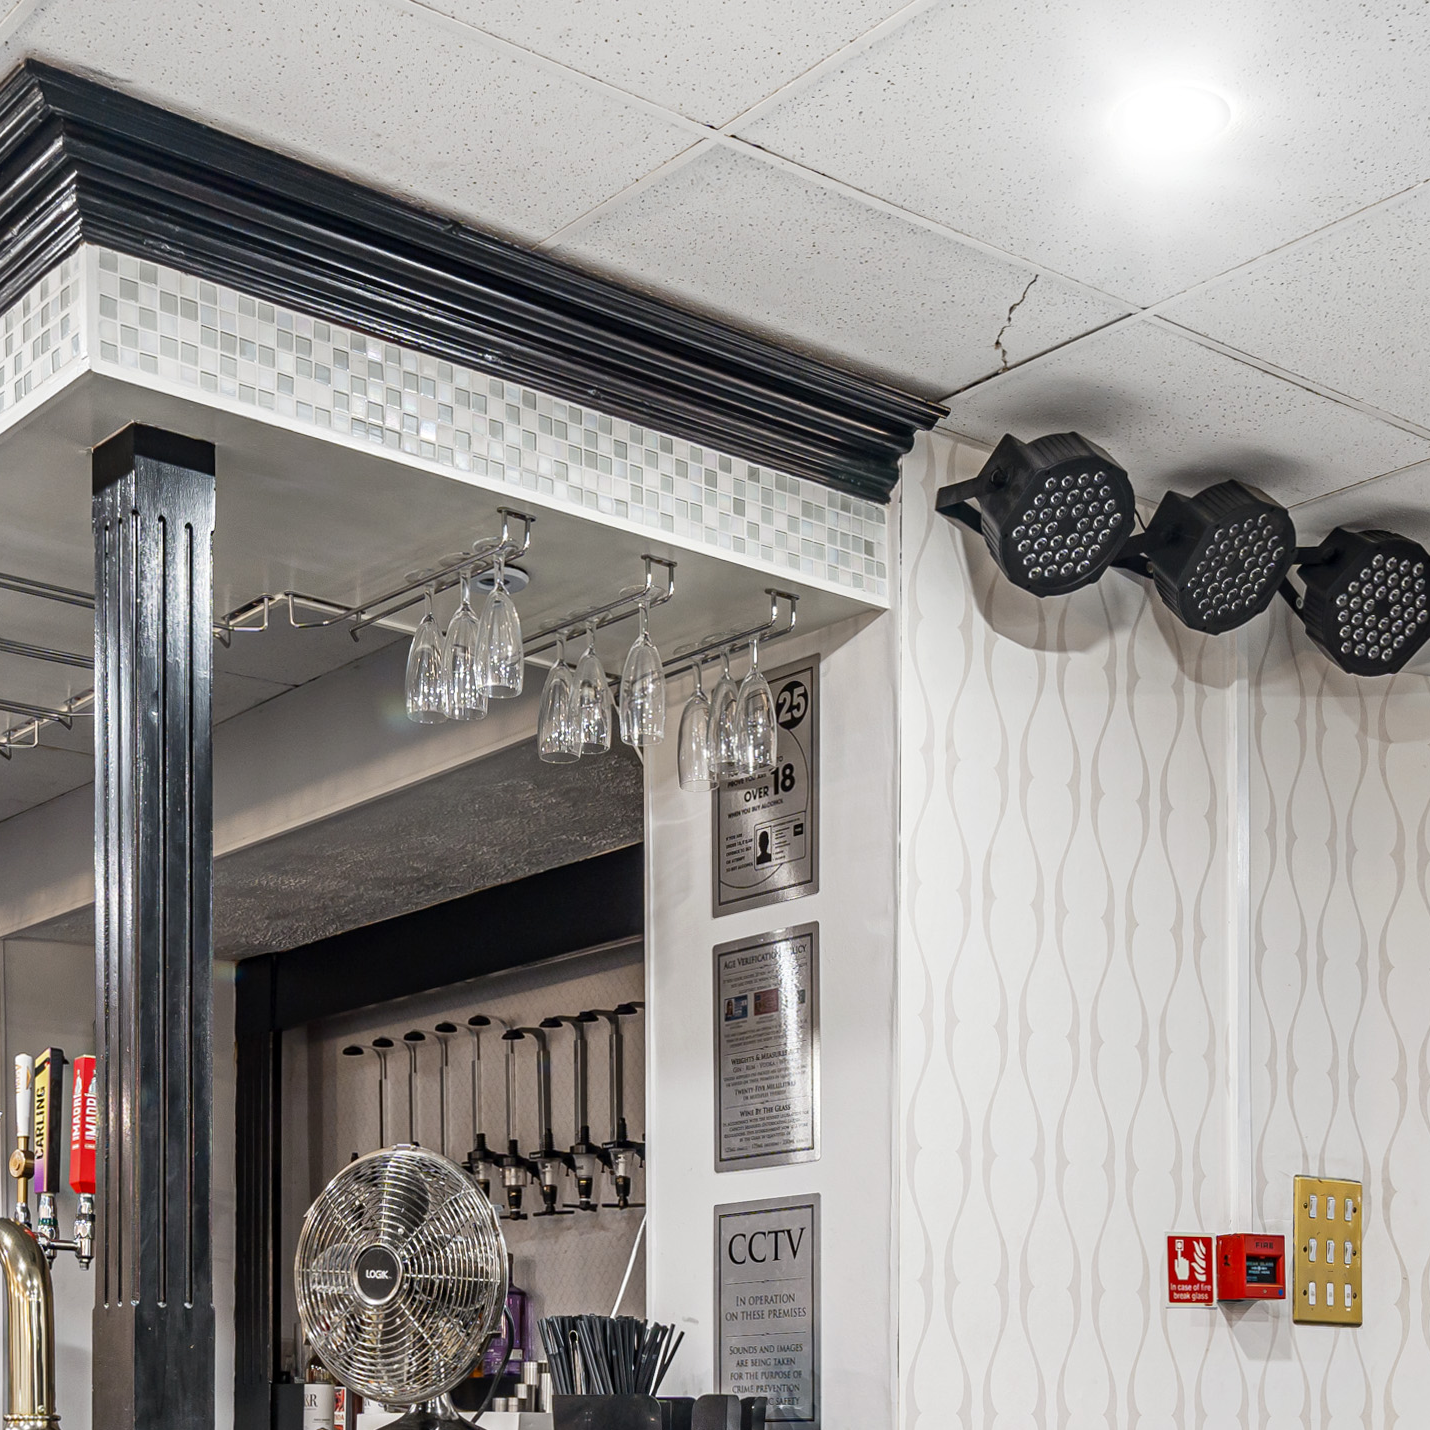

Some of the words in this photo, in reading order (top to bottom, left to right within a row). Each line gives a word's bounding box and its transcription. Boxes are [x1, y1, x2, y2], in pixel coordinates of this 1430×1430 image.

[777, 685, 807, 724] 25
[770, 762, 796, 796] 18
[743, 785, 770, 803] OVER
[723, 959, 736, 970] AGE
[35, 1086, 46, 1160] CARLING
[728, 1226, 807, 1265] CCTV
[1255, 1241, 1274, 1249] FIRE
[365, 1269, 389, 1280] LOGIK
[1170, 1282, 1177, 1291] In
[1177, 1283, 1192, 1291] case
[1192, 1282, 1200, 1291] of
[1200, 1282, 1212, 1292] fire
[735, 1295, 746, 1307] IN
[748, 1293, 796, 1306] OPERATION
[1173, 1291, 1191, 1300] break
[1191, 1291, 1209, 1302] glass
[724, 1311, 739, 1322] ON
[741, 1309, 765, 1321] THESE
[767, 1307, 807, 1319] PREMISES
[729, 1345, 758, 1356] SOUNDS
[759, 1344, 775, 1354] AND
[776, 1343, 804, 1353] IMAGES
[735, 1358, 749, 1368] ARE
[750, 1357, 771, 1367] BEING
[773, 1356, 796, 1367] TAKEN
[730, 1371, 744, 1381] FOR
[745, 1371, 759, 1381] THE
[761, 1370, 791, 1380] PURPOSE
[793, 1369, 803, 1379] OF
[731, 1384, 754, 1394] CRIME
[755, 1383, 800, 1394] PREVENTION
[775, 1396, 801, 1406] SAFETY
